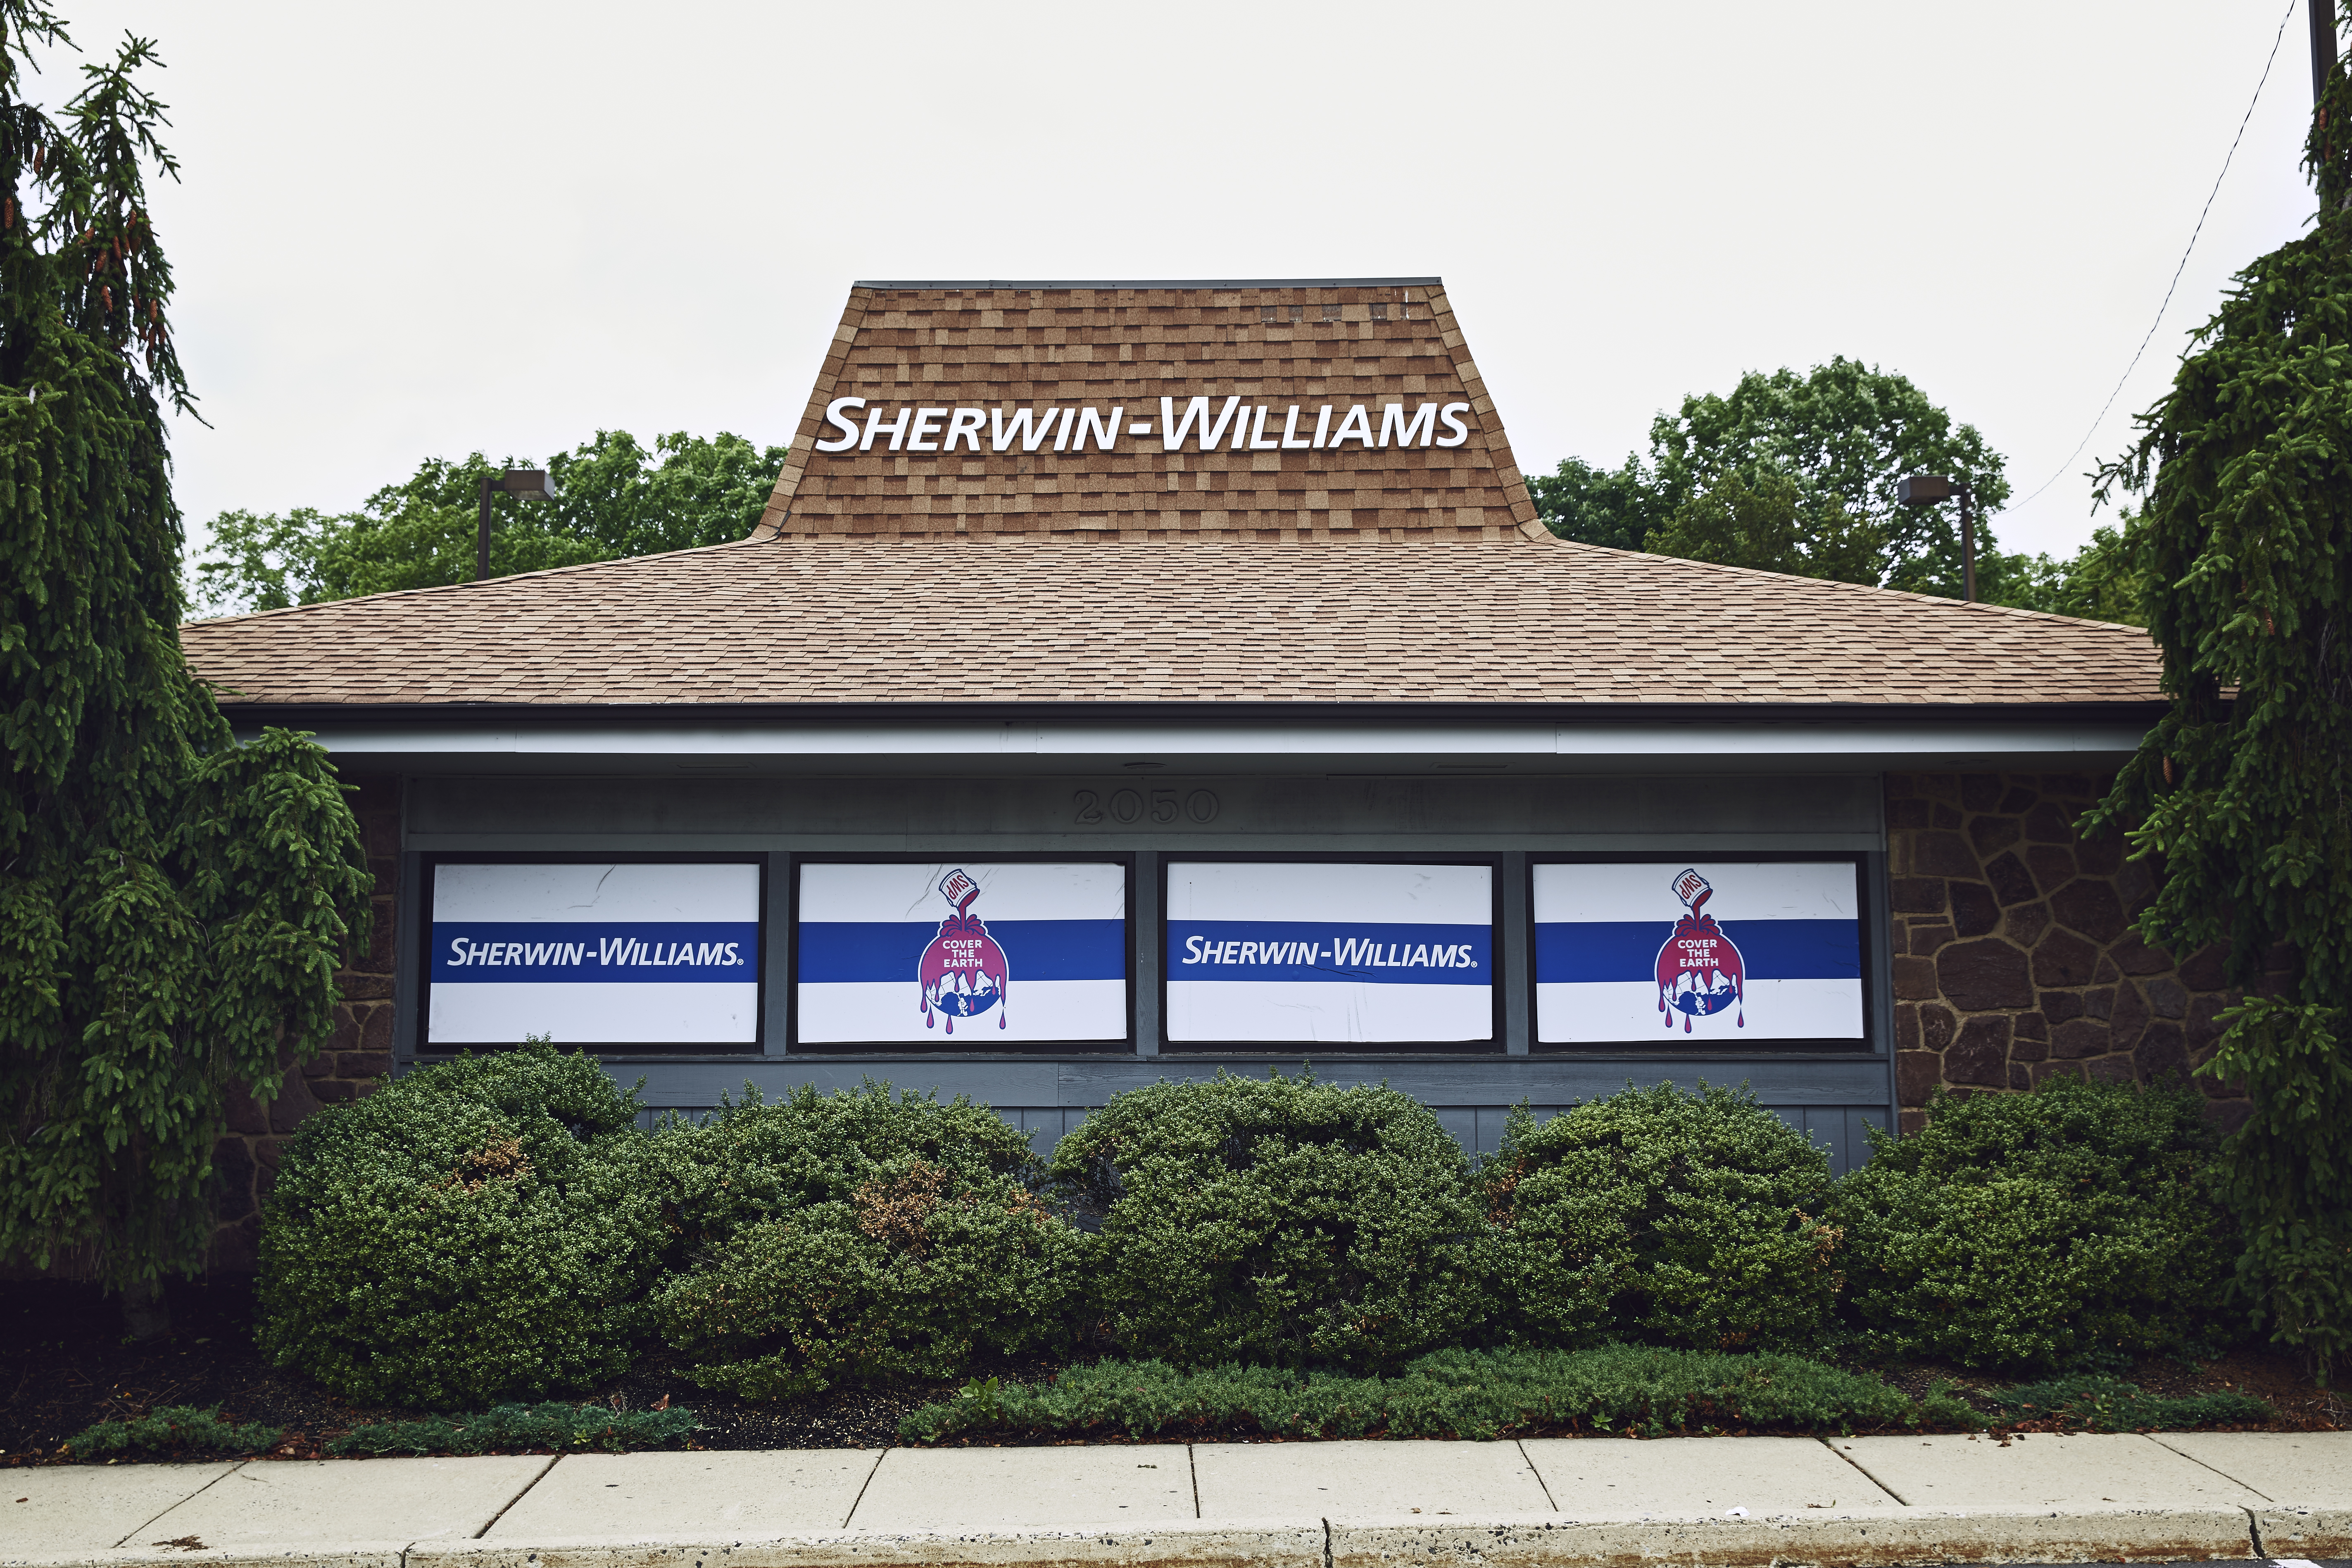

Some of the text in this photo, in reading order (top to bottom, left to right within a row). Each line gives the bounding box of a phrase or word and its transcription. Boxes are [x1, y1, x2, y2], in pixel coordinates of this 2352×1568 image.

[815, 396, 1469, 453] SHERWIN-WILLIAMS
[1075, 789, 1219, 825] 2050
[947, 875, 969, 900] SWP
[1679, 874, 1702, 899] SWP
[942, 940, 982, 949] COVER
[1678, 939, 1717, 949] COVER
[951, 949, 975, 958] THE
[1687, 949, 1710, 957] THE
[944, 959, 983, 968] EARTH
[1679, 958, 1719, 967] EARTH
